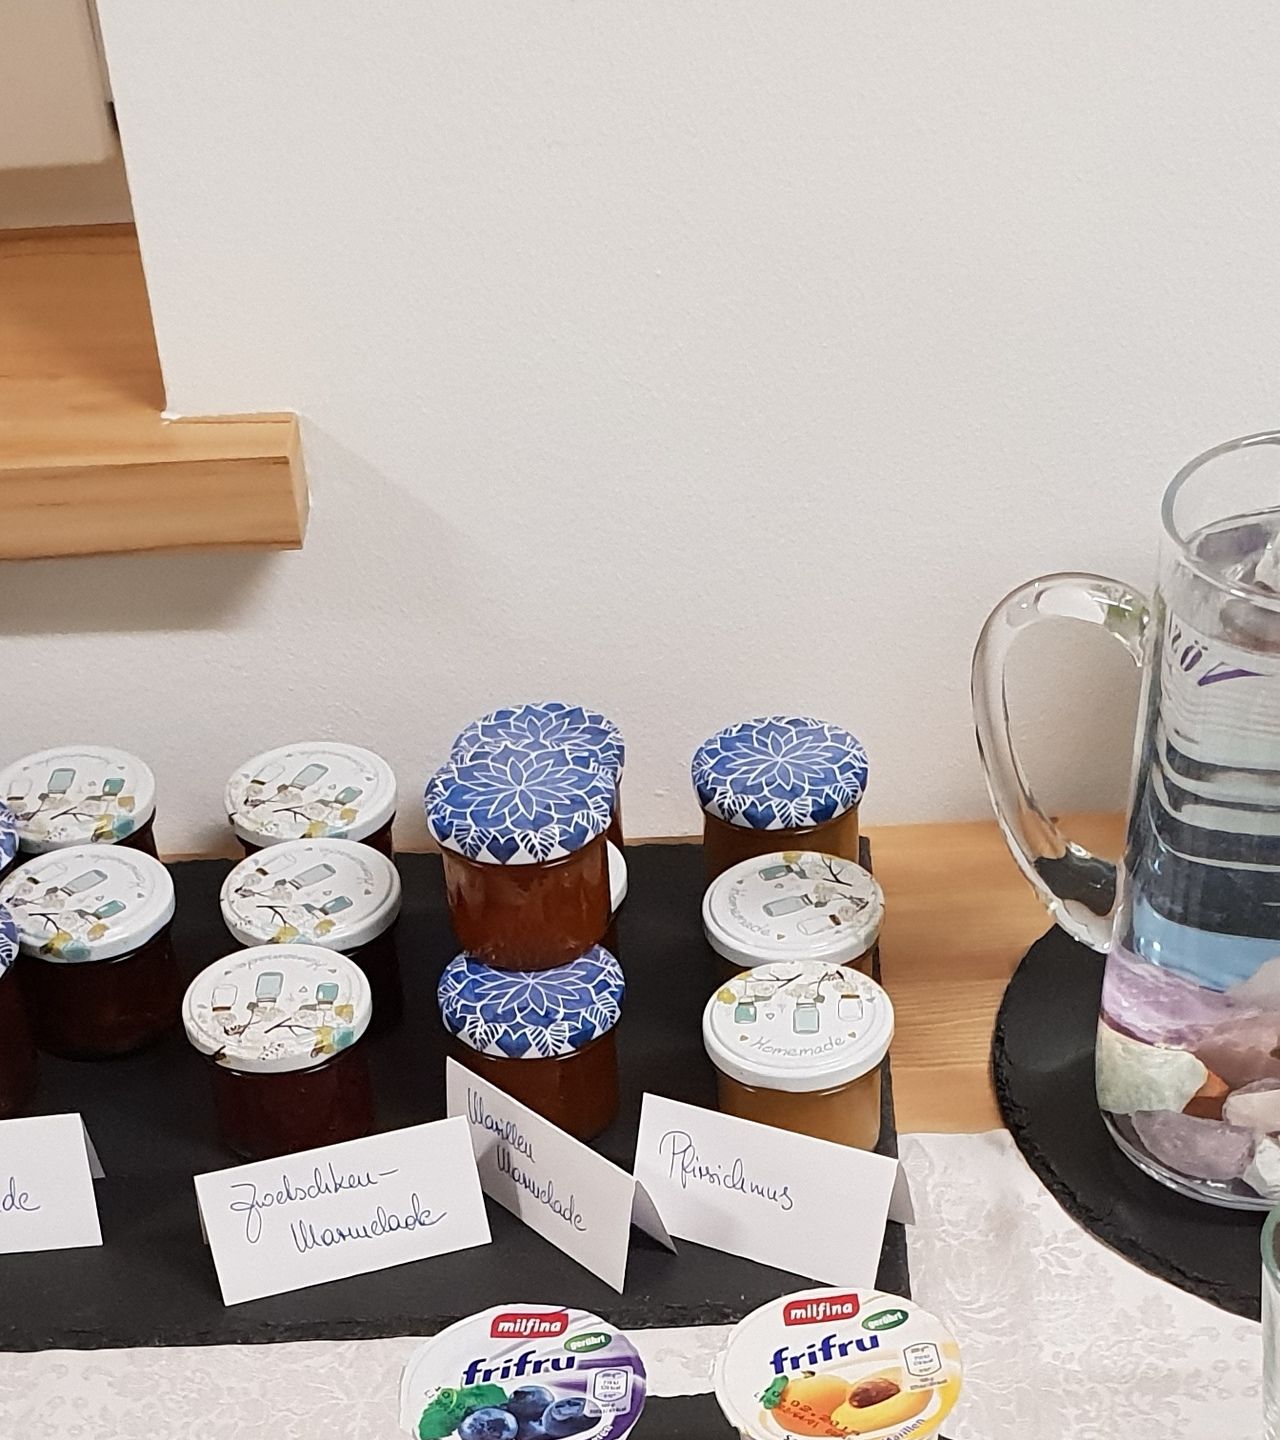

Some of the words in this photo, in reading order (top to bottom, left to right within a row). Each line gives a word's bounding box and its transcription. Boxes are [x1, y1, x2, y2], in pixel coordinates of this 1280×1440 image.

[751, 1035, 847, 1057] Homemade
[467, 1087, 536, 1163] Marillen
[497, 1144, 587, 1232] Marmelade
[659, 1129, 795, 1211] Pfirsichmus
[290, 1192, 448, 1254] Marmelade
[497, 1316, 562, 1338] milfina
[790, 1301, 853, 1320] milfina
[462, 1350, 575, 1385] frifru
[769, 1333, 880, 1375] frifru
